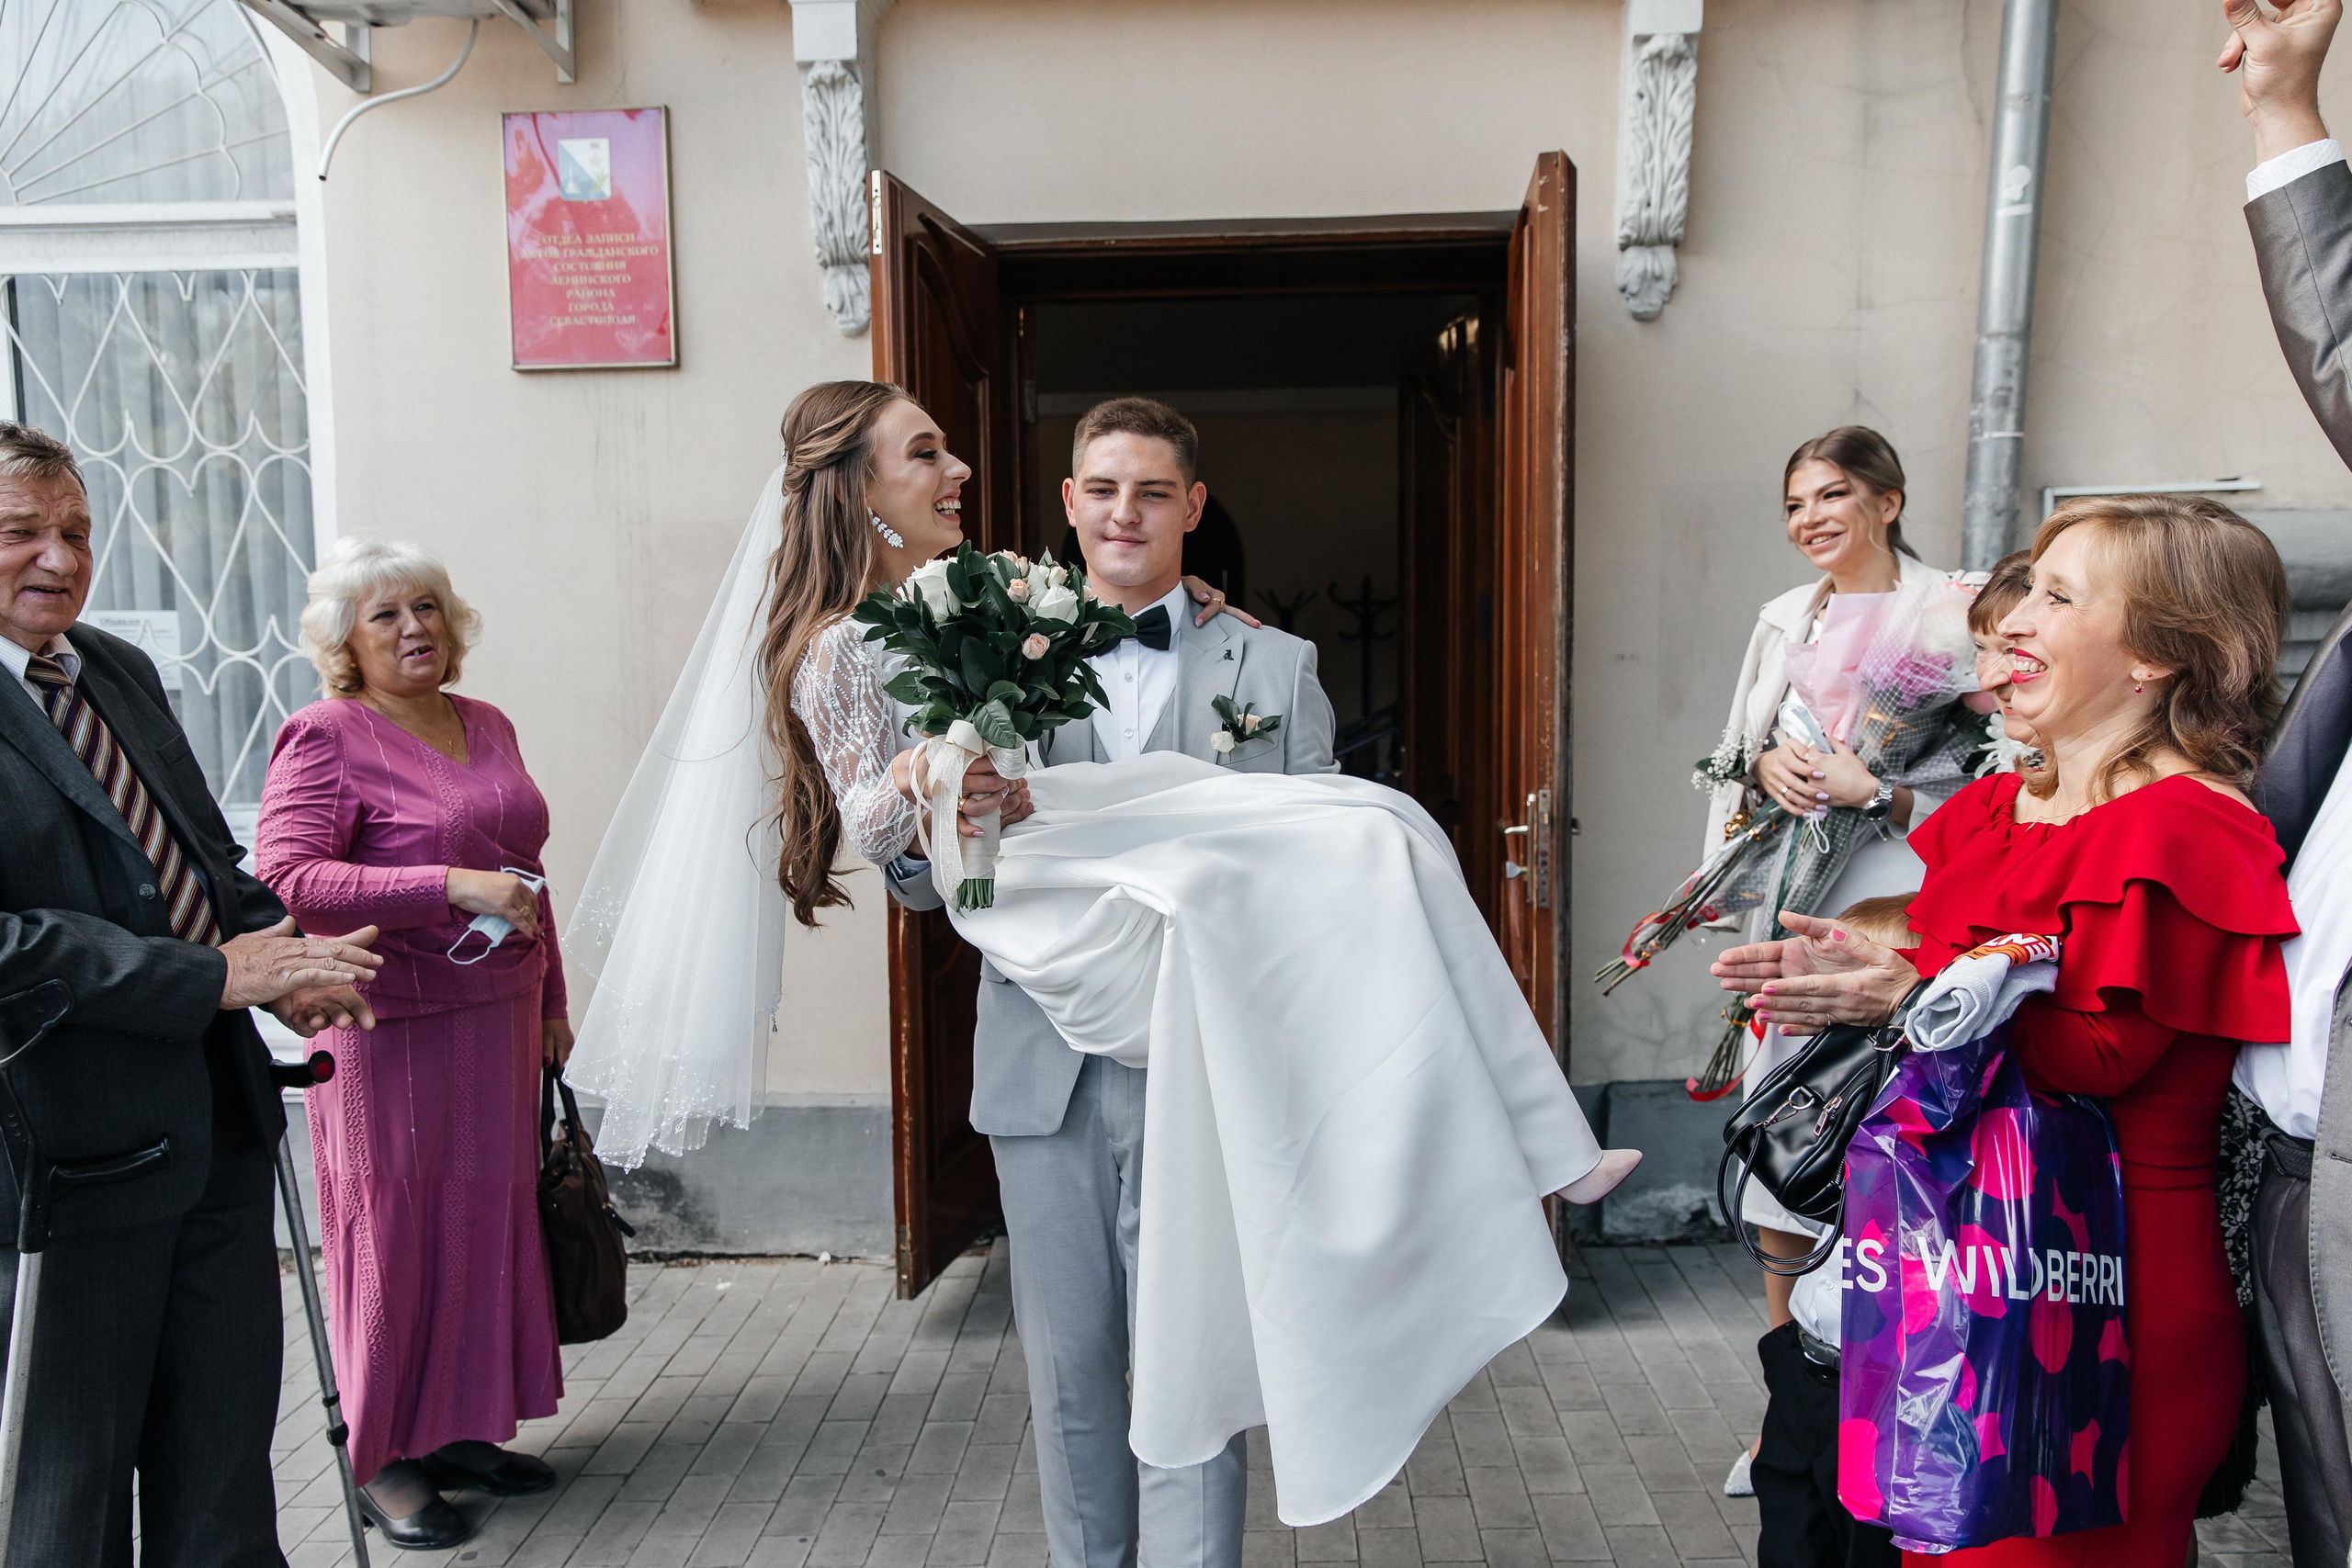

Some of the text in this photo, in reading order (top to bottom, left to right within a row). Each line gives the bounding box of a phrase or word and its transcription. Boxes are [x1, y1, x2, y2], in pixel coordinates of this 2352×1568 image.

[542, 232, 635, 246] ОТДЕЛ ЗАПИСИ
[562, 245, 660, 258] ГРАЖДАНСКОГО
[553, 261, 627, 273] СОСТОЯНИЯ
[551, 274, 632, 286] ЛЕНИНСКОГО
[566, 288, 616, 299] РАЙОНА
[568, 301, 616, 313] ГОРОДА
[548, 314, 636, 327] СЕВАСТОПОЛЯ
